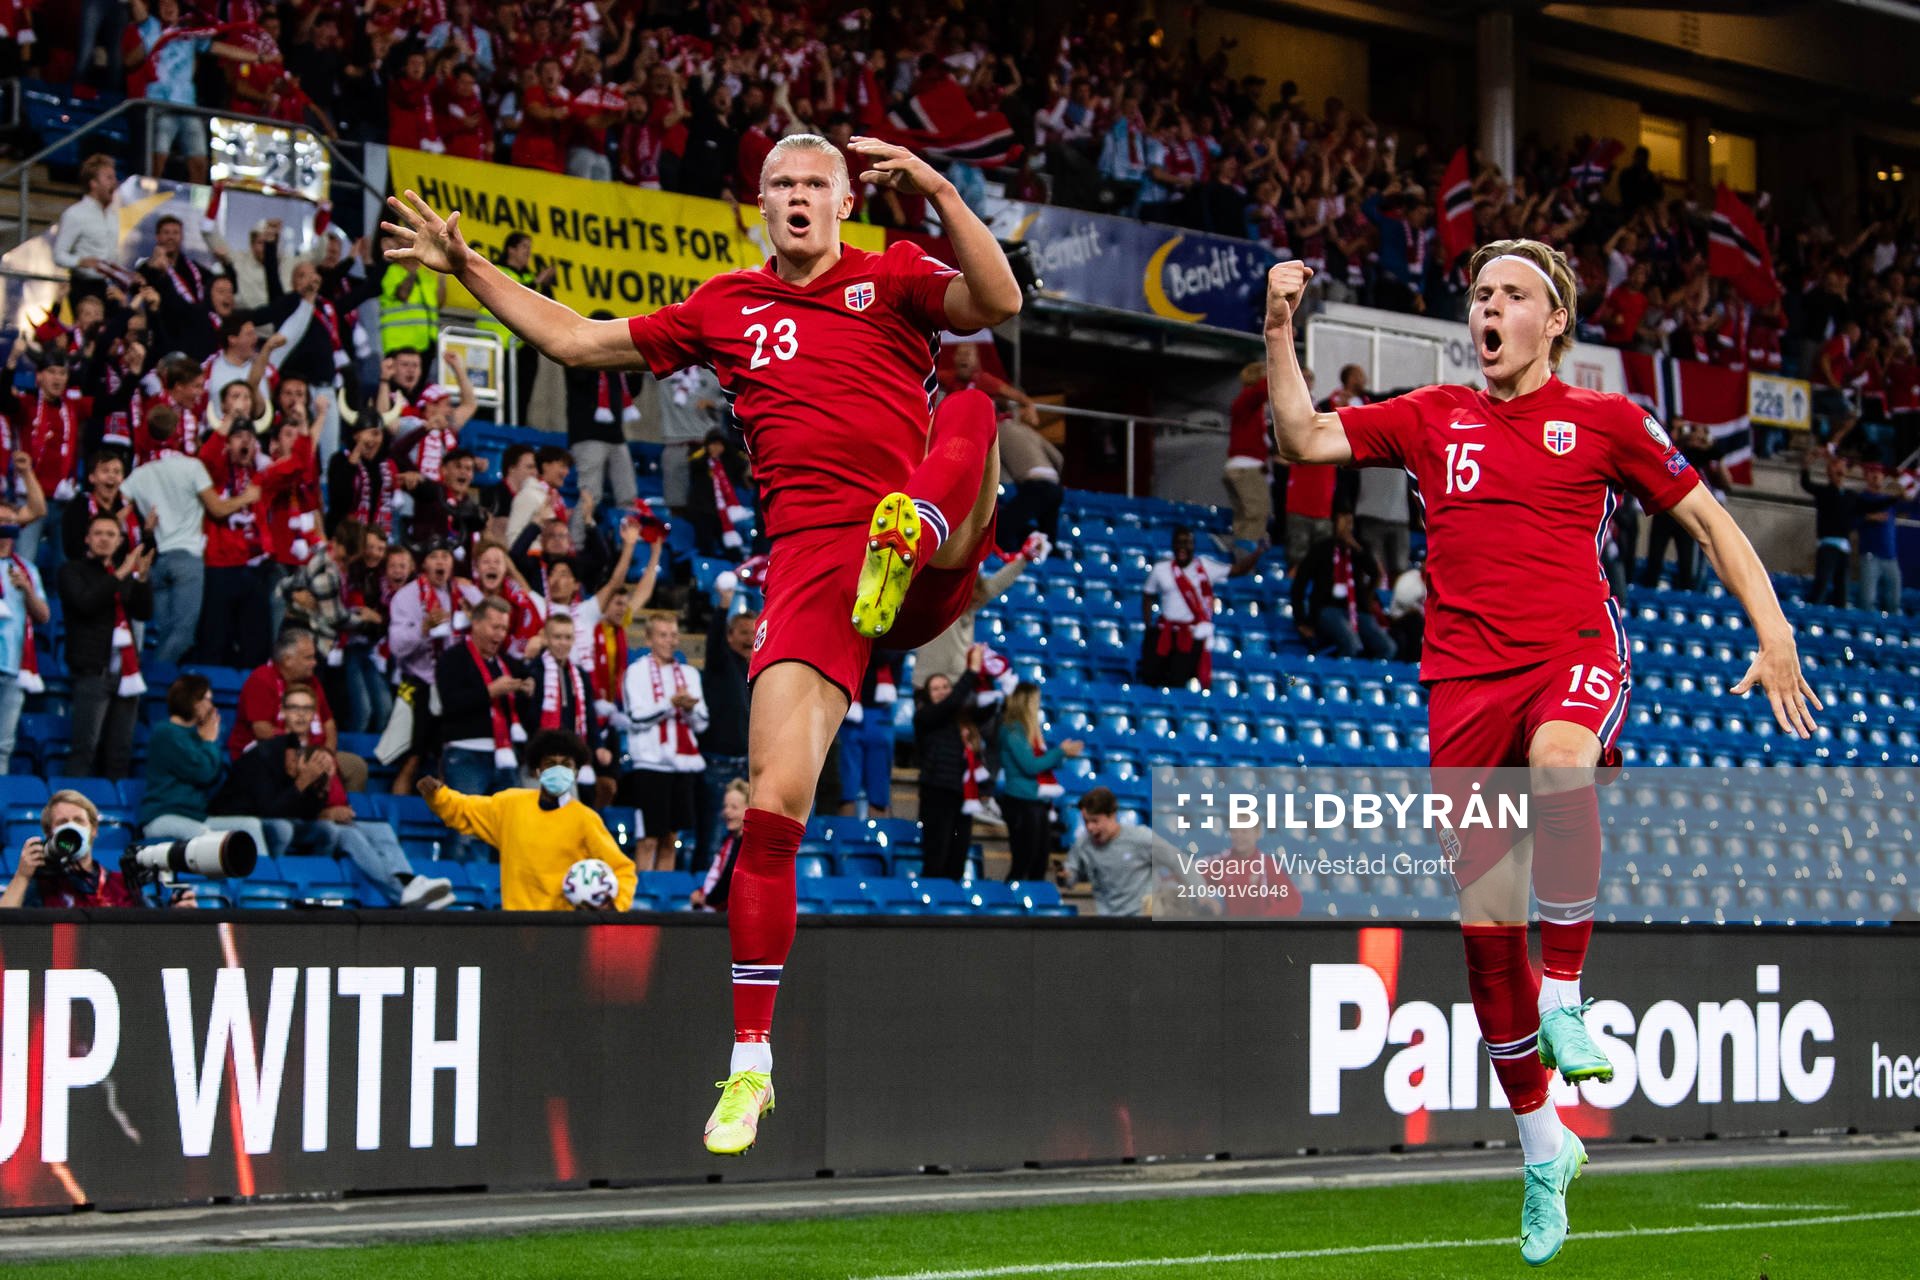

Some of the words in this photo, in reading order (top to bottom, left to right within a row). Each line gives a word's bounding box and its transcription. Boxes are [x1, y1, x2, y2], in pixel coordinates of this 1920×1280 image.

[417, 174, 541, 233] HUMAN
[548, 204, 669, 254] RIGHTS
[674, 225, 734, 264] FOR
[1028, 221, 1103, 275] Bendit
[1167, 244, 1241, 300] Bendit
[743, 317, 799, 370] 23
[1444, 442, 1486, 495] 15
[1568, 664, 1614, 701] 15
[161, 966, 482, 1157] WITH
